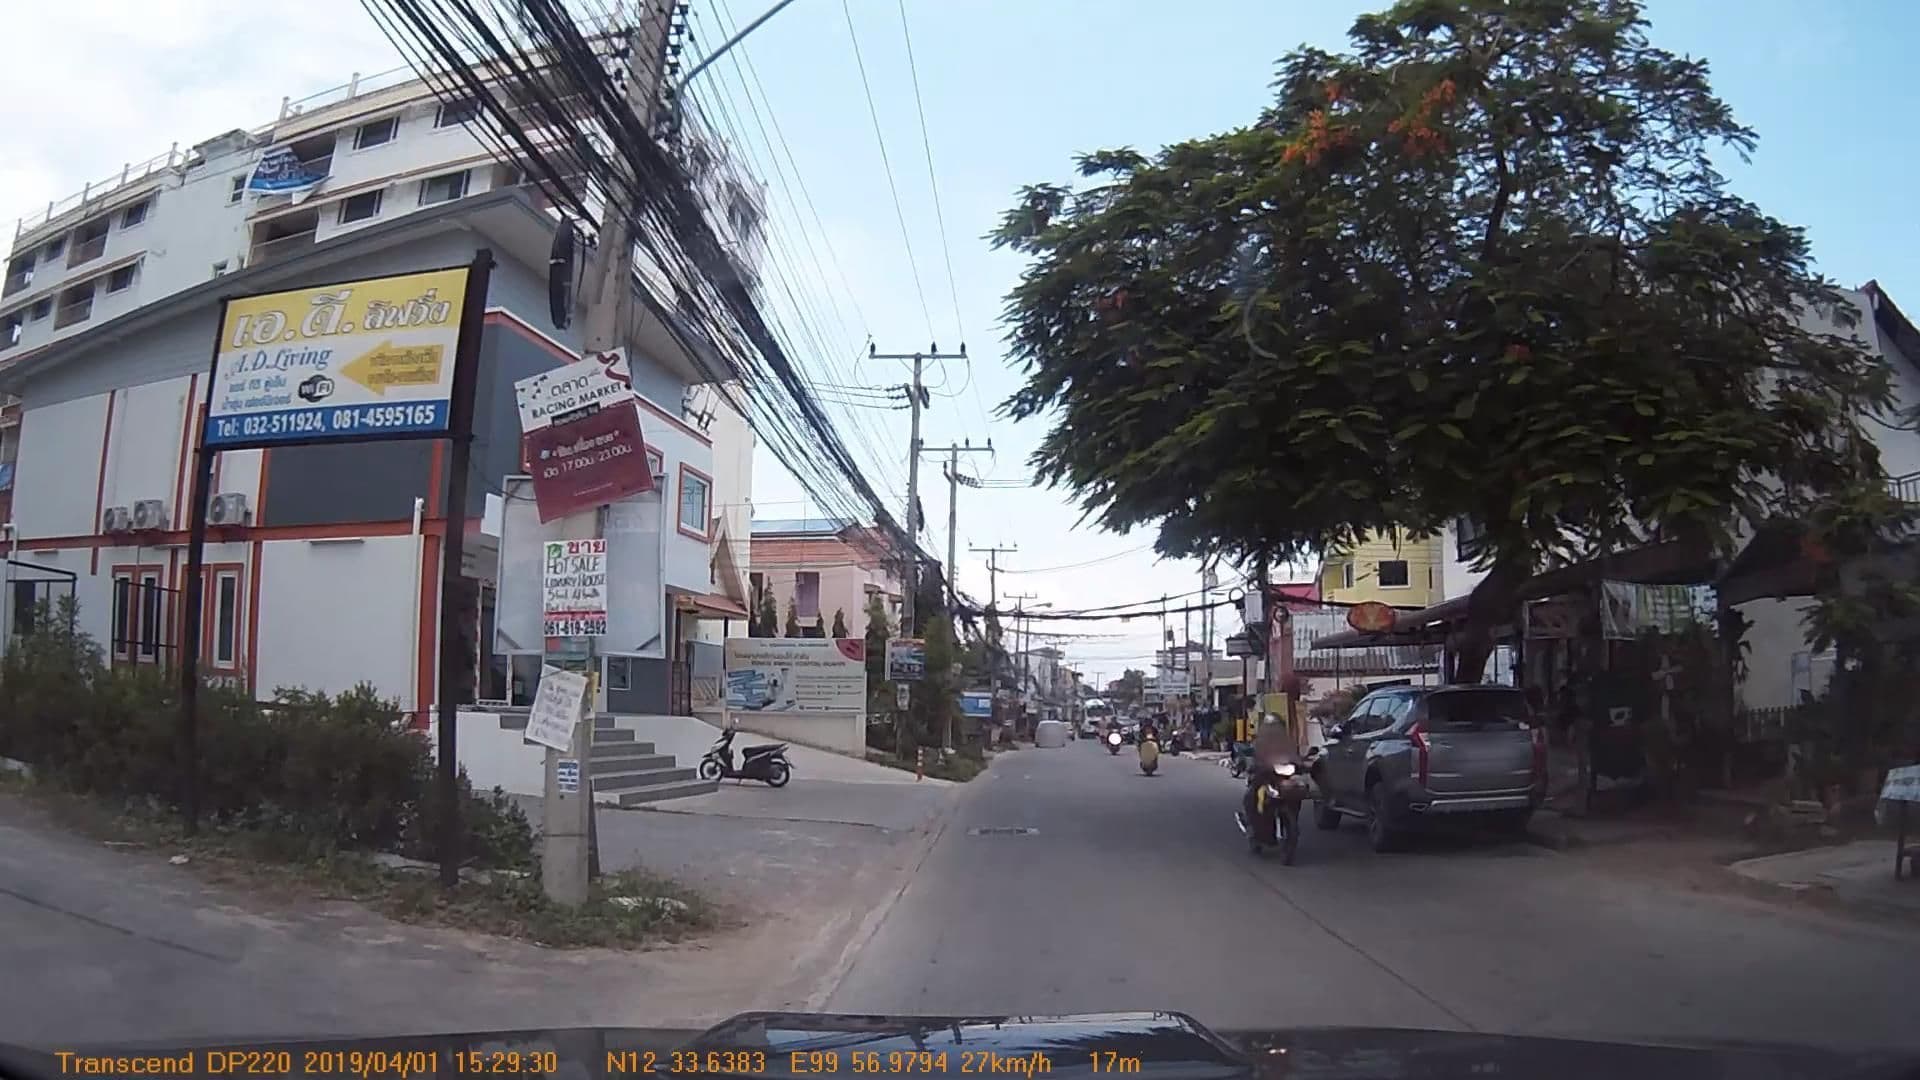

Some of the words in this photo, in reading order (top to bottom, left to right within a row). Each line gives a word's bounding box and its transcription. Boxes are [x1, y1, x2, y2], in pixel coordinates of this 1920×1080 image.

[532, 397, 576, 419] RACING
[578, 381, 622, 404] MARKET
[218, 418, 240, 437] Tel:
[243, 411, 326, 436] 032-511924,
[332, 404, 435, 431] 081-4595165
[567, 541, 606, 554] ขาย
[546, 557, 570, 575] HOT
[571, 556, 602, 574] SALE
